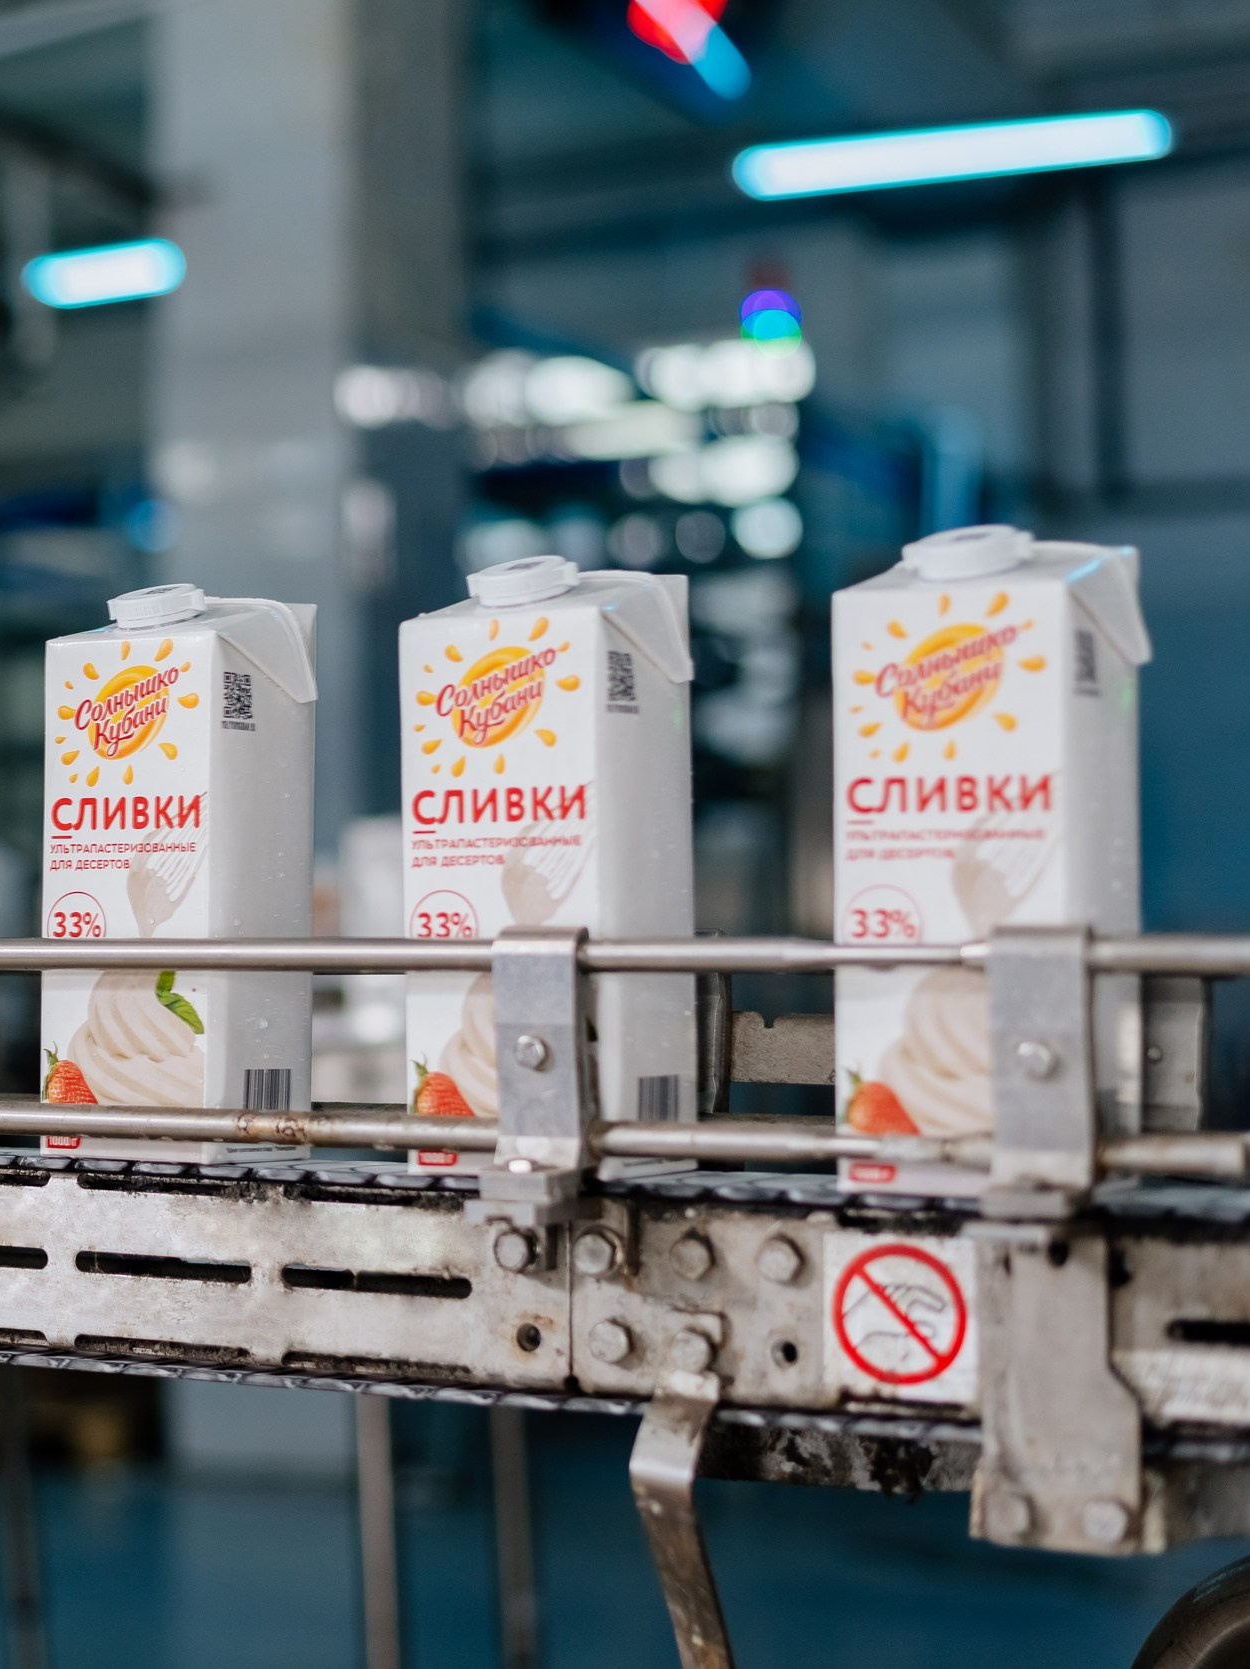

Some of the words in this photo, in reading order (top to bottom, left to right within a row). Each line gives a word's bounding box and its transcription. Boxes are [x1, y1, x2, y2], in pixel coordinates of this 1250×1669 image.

[875, 626, 1018, 698] Солнышко
[74, 666, 180, 731] Солнышко
[436, 648, 557, 716] Солнышко
[93, 698, 167, 757] Кубани
[458, 681, 543, 745] Кубани
[412, 784, 586, 825] СЛИВКИ
[846, 775, 1052, 813] СЛИВКИ
[51, 795, 201, 831] СЛИВКИ
[50, 841, 196, 854] УЛЬТРАПАСТЕРИЗОВАННЫЕ
[411, 834, 582, 850] УЛЬТРАПАСТЕРИЗОВАННЫЕ
[50, 859, 72, 871] ДЛЯ
[75, 857, 131, 871] ДЕСЕРТОВ
[411, 856, 437, 868] ДЛЯ
[441, 854, 505, 868] ДЕСЕРТОВ
[52, 911, 101, 938] 33%
[417, 912, 472, 939] 33%
[851, 908, 916, 939] 33%
